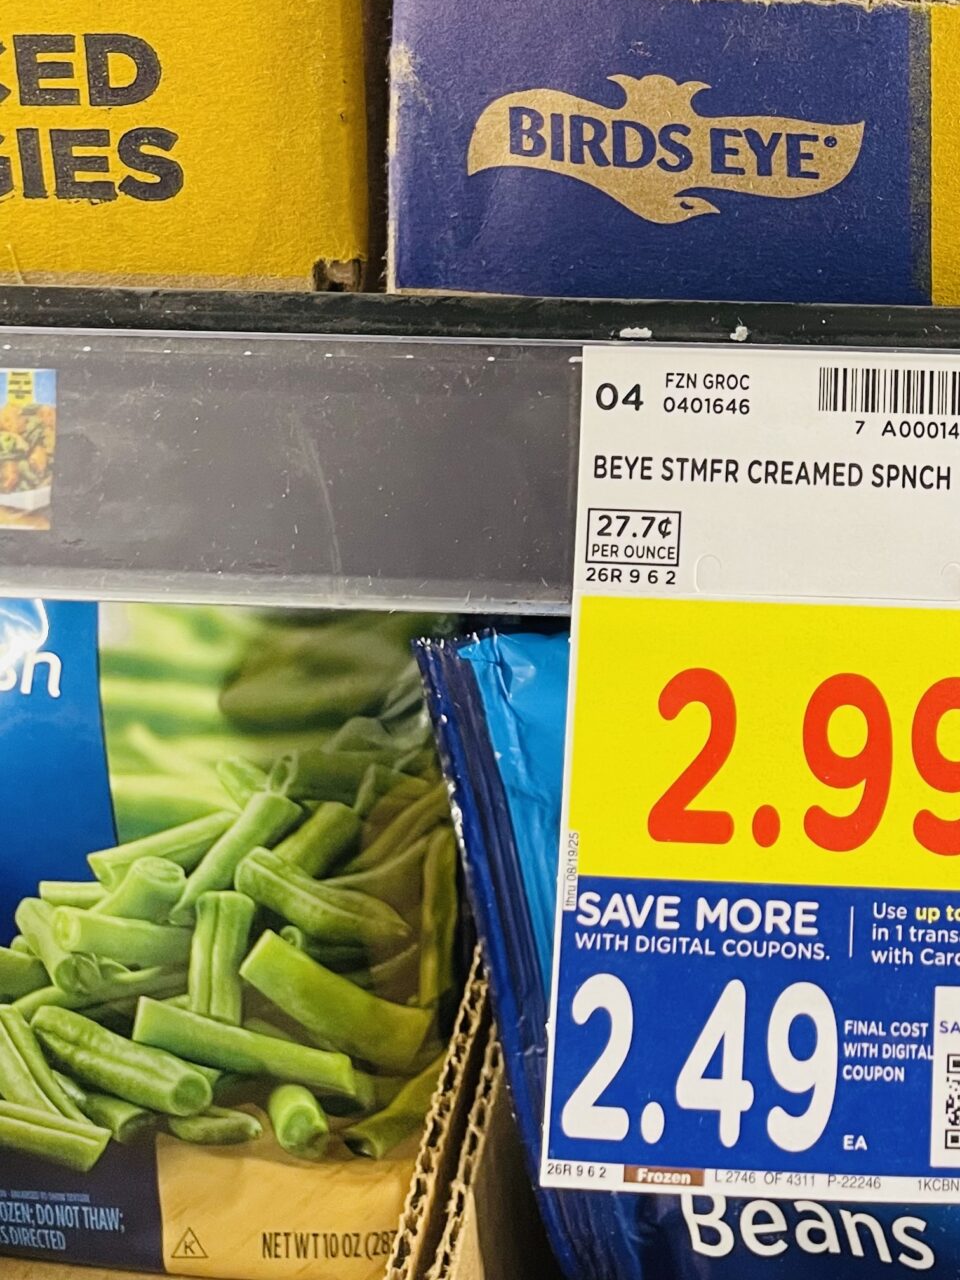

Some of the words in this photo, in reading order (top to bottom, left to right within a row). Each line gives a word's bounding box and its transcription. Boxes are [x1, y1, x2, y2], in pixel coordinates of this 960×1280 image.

[508, 106, 693, 172] BIRDS
[710, 128, 821, 180] EYE
[665, 373, 697, 389] FZN
[702, 374, 750, 391] GROC
[595, 382, 644, 412] 04
[663, 396, 750, 415] 0401646
[855, 420, 866, 435] 7
[593, 455, 653, 480] BEYE
[661, 457, 739, 483] STMFR
[748, 460, 863, 487] CREAMED
[871, 463, 951, 490] SPNCH
[597, 514, 673, 539] 27.7¢
[592, 543, 619, 558] PER
[624, 545, 676, 560] OUNCE
[586, 567, 623, 583] 26R
[629, 569, 641, 584] 9
[647, 570, 659, 585] 6
[665, 570, 677, 586] 2
[576, 891, 681, 930] SAVE
[696, 896, 820, 936] MORE
[873, 902, 908, 919] Use
[915, 906, 941, 924] up
[871, 923, 889, 942] in
[895, 924, 903, 942] 1
[575, 932, 629, 952] WITH
[634, 934, 717, 956] DIGITAL
[722, 939, 831, 961] COUPONS.
[871, 947, 914, 965] with
[844, 1020, 886, 1036] FINAL
[890, 1022, 928, 1038] COST
[844, 1042, 878, 1058] WITH
[882, 1043, 934, 1060] DIGITAL
[561, 973, 840, 1153] 2.49
[842, 1065, 905, 1082] COUPON
[843, 1134, 868, 1151] EA
[547, 1163, 571, 1178] 26R
[637, 1167, 691, 1185] Frozen
[726, 1172, 755, 1185] 2746
[764, 1173, 781, 1185] OF
[786, 1173, 815, 1187] 4311
[827, 1175, 881, 1190] P-22246
[36, 1204, 54, 1225] DO
[56, 1205, 79, 1229] NOT
[81, 1207, 125, 1233] THAW;
[10, 1226, 66, 1250] DIRECTED
[262, 1232, 290, 1259] NET
[292, 1232, 318, 1258] WT
[321, 1232, 339, 1257] 10
[342, 1232, 361, 1257] OZ
